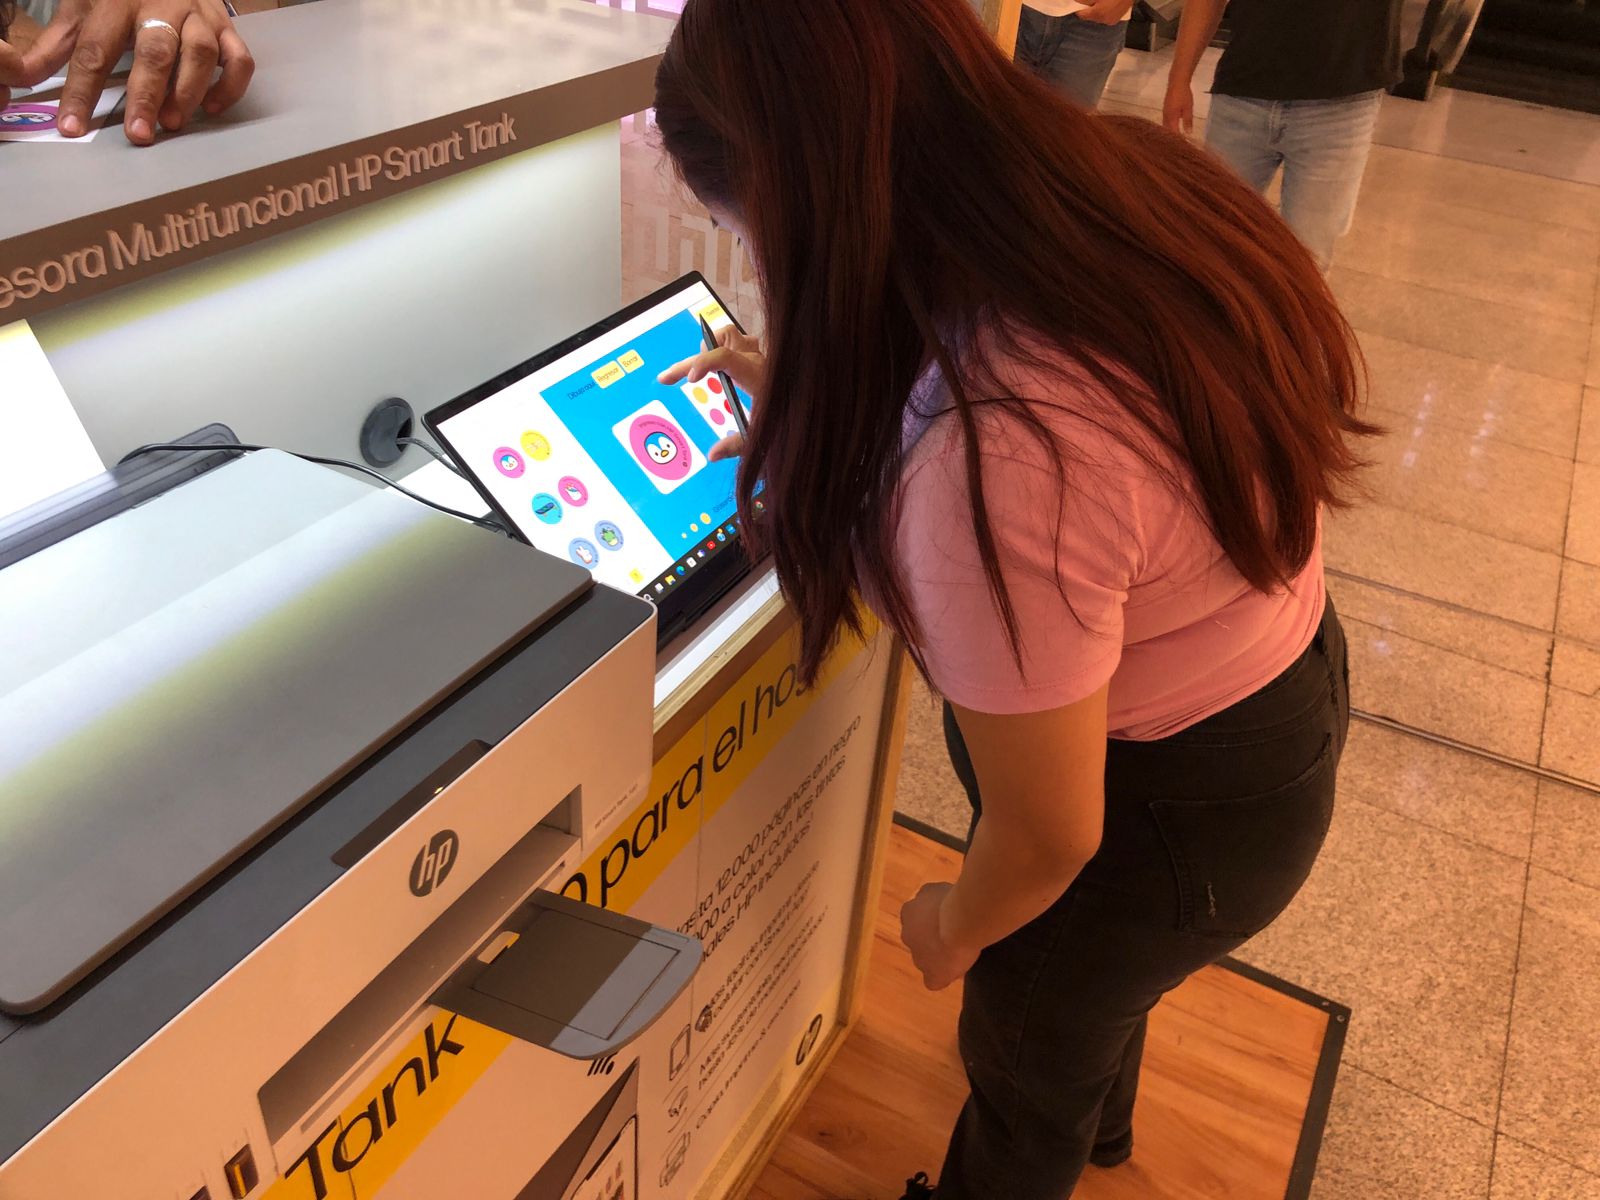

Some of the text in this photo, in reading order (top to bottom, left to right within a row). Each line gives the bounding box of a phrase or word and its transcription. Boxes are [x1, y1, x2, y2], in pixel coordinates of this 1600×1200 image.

[106, 164, 339, 271] Multifuncional
[339, 153, 382, 197] HP
[384, 130, 465, 182] Smart
[463, 112, 517, 154] Tank
[411, 832, 457, 895] hp
[677, 892, 712, 935] asta
[828, 715, 861, 759] negro
[721, 896, 731, 914] a
[733, 850, 765, 900] color
[768, 821, 792, 856] con
[814, 755, 846, 799] tintas
[737, 884, 757, 920] HP
[284, 1012, 465, 1200] Tank
[600, 754, 704, 908] para
[713, 701, 745, 773] el
